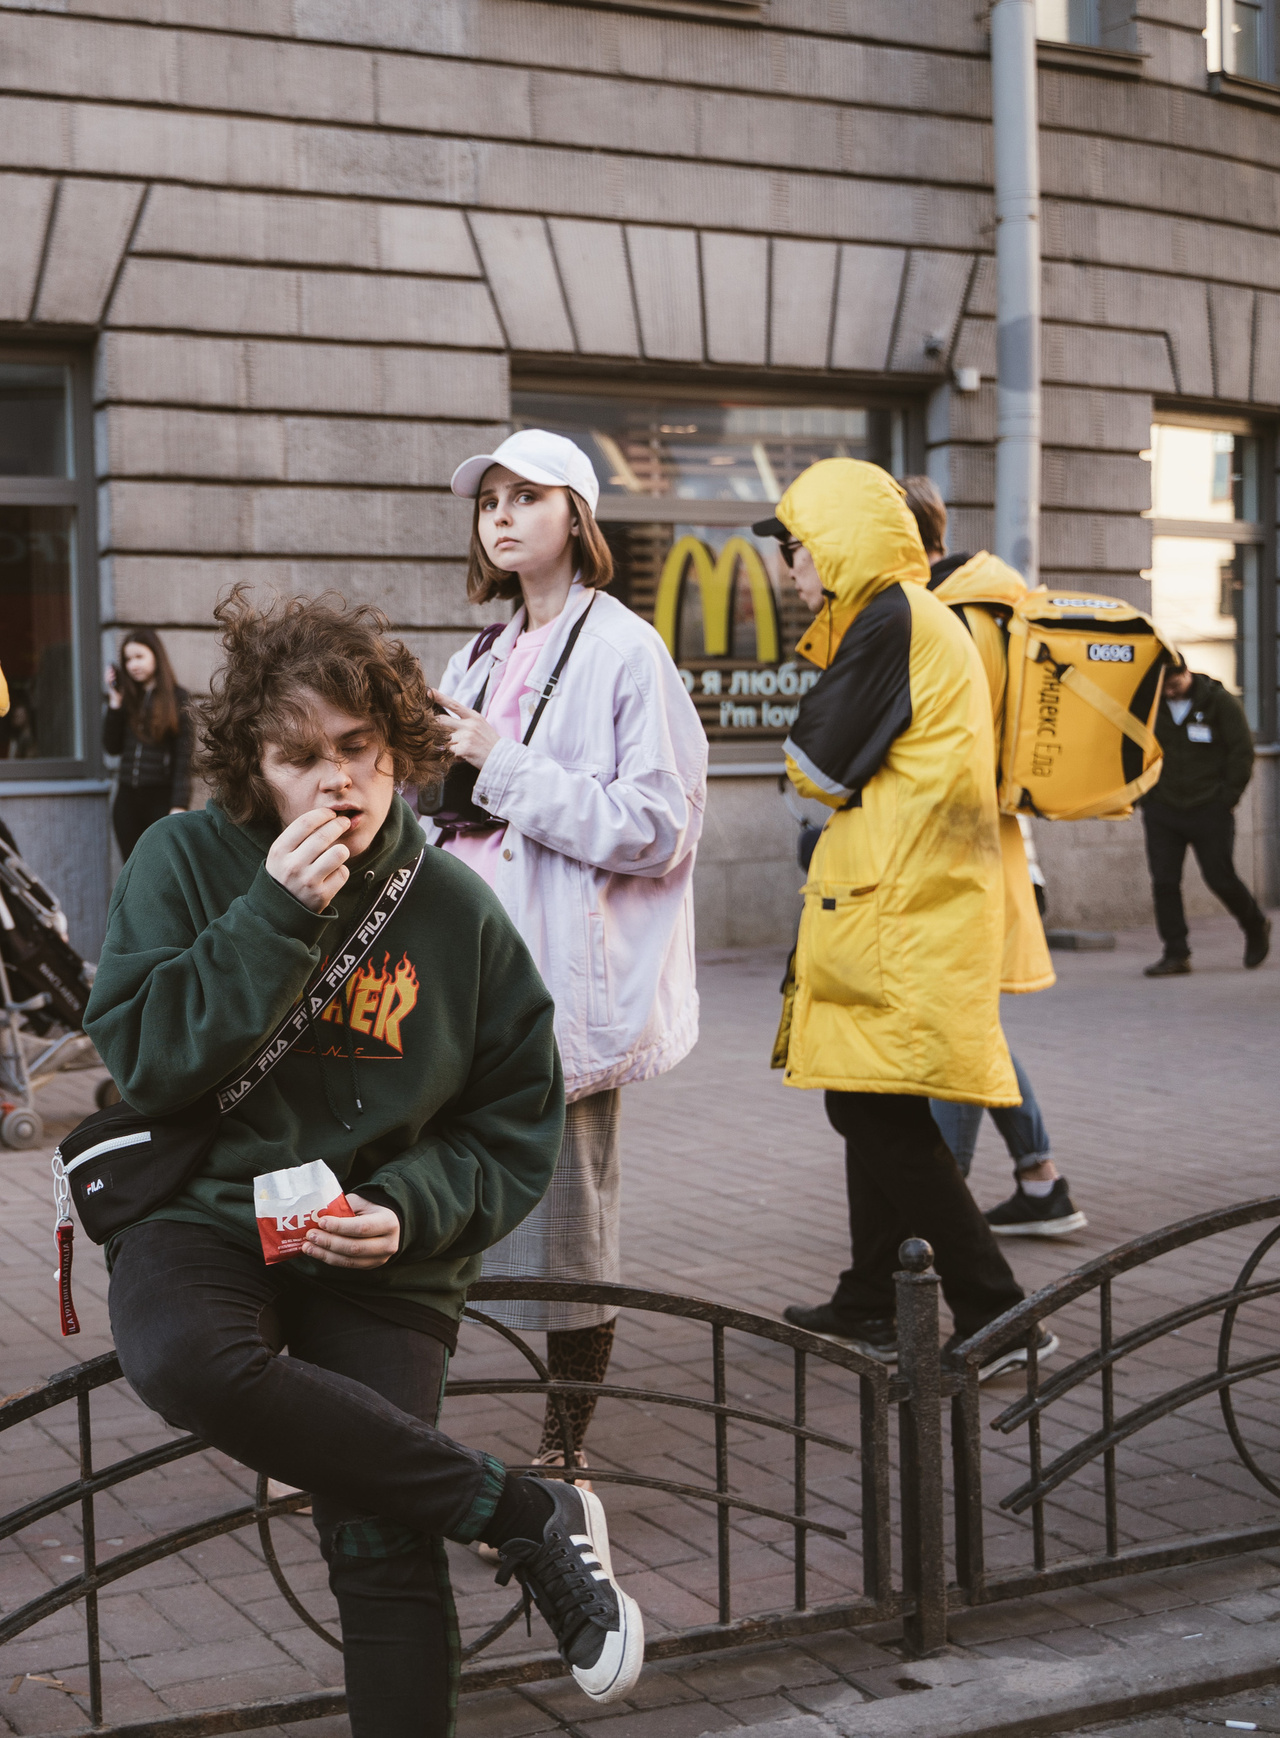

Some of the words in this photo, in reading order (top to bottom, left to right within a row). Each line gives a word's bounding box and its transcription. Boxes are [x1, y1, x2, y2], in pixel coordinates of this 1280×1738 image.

[1089, 643, 1133, 663] 0696
[700, 669, 721, 695] я
[728, 661, 824, 695] любл
[720, 701, 757, 728] i'm
[761, 700, 800, 728] lov
[1031, 743, 1062, 777] Еда
[217, 1080, 252, 1110] FILA
[257, 1039, 289, 1072] FILA
[325, 953, 357, 989] FILA
[357, 910, 387, 946] FILA
[386, 868, 412, 902] FILA
[86, 1178, 105, 1197] FILA
[67, 1316, 77, 1333] ILA
